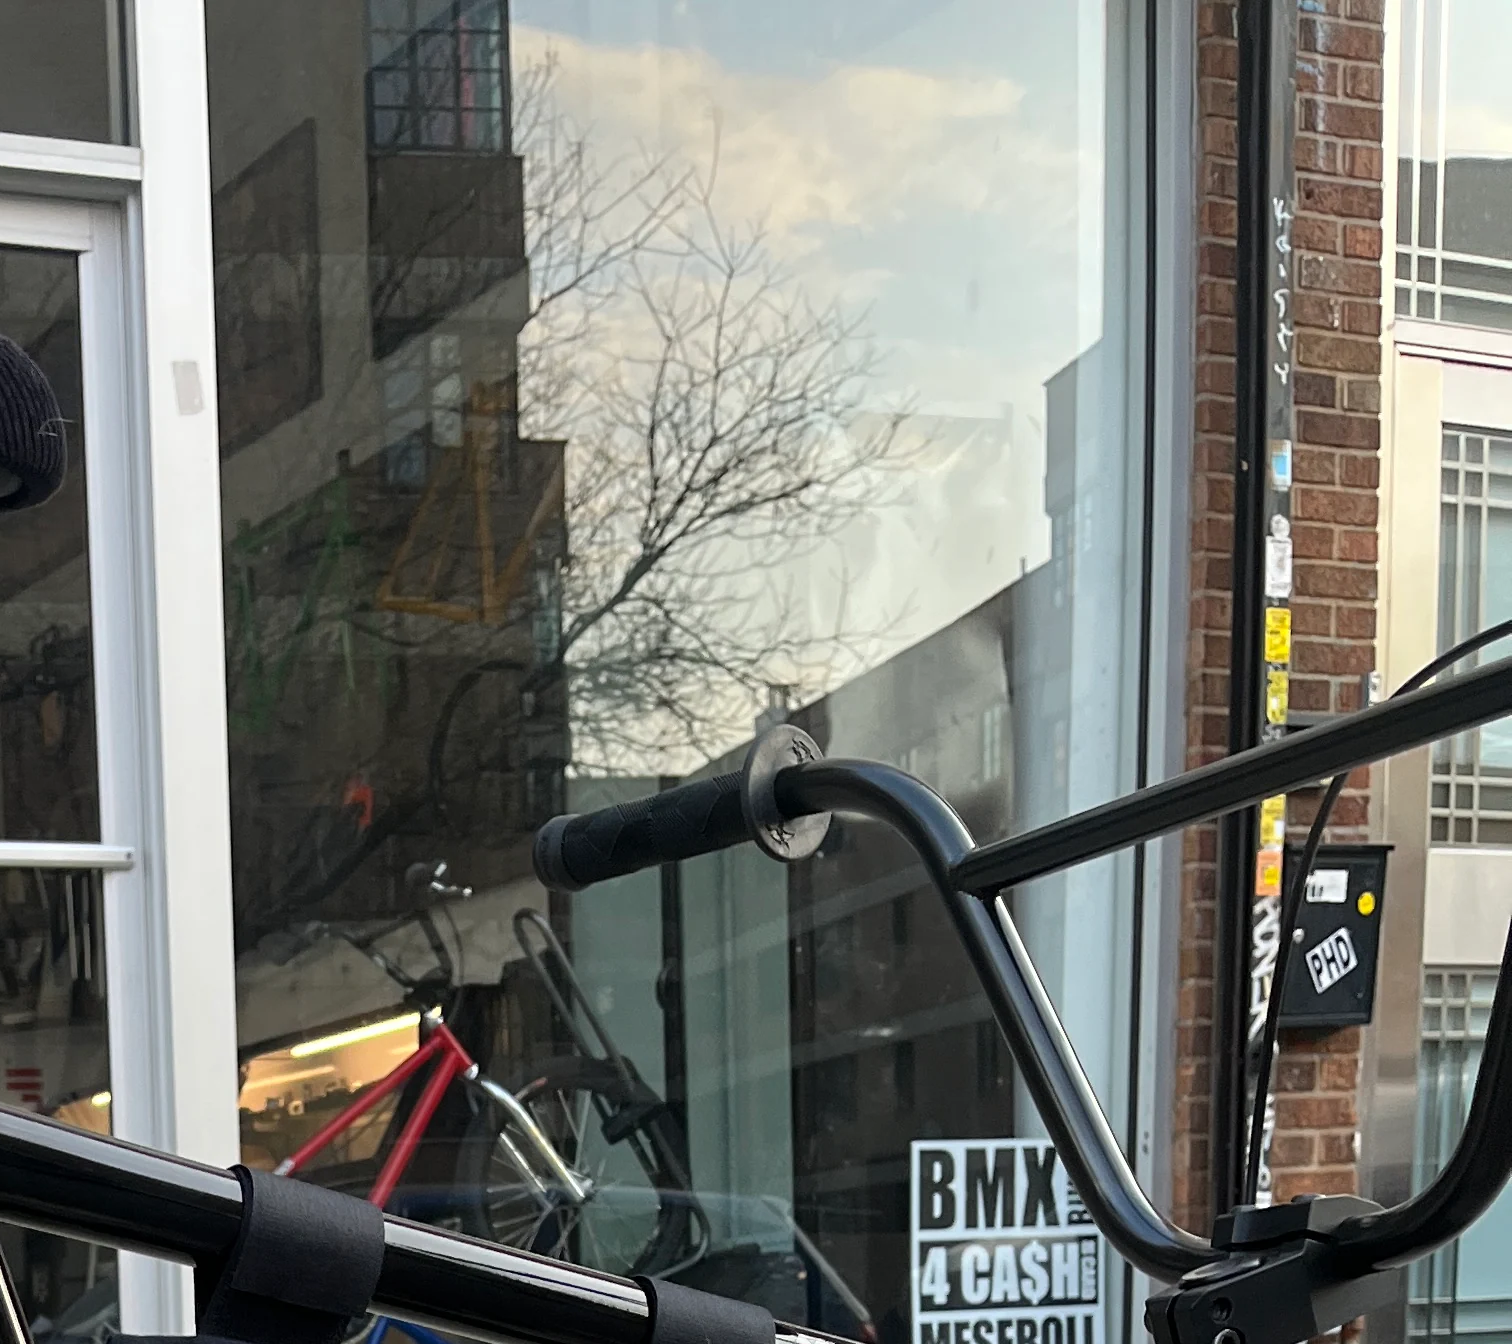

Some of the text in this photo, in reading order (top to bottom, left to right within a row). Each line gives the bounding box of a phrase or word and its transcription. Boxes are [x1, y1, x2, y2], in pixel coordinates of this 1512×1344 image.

[919, 1147, 1061, 1230] BMX
[921, 1246, 951, 1305] 4
[960, 1239, 1080, 1306] CA$H
